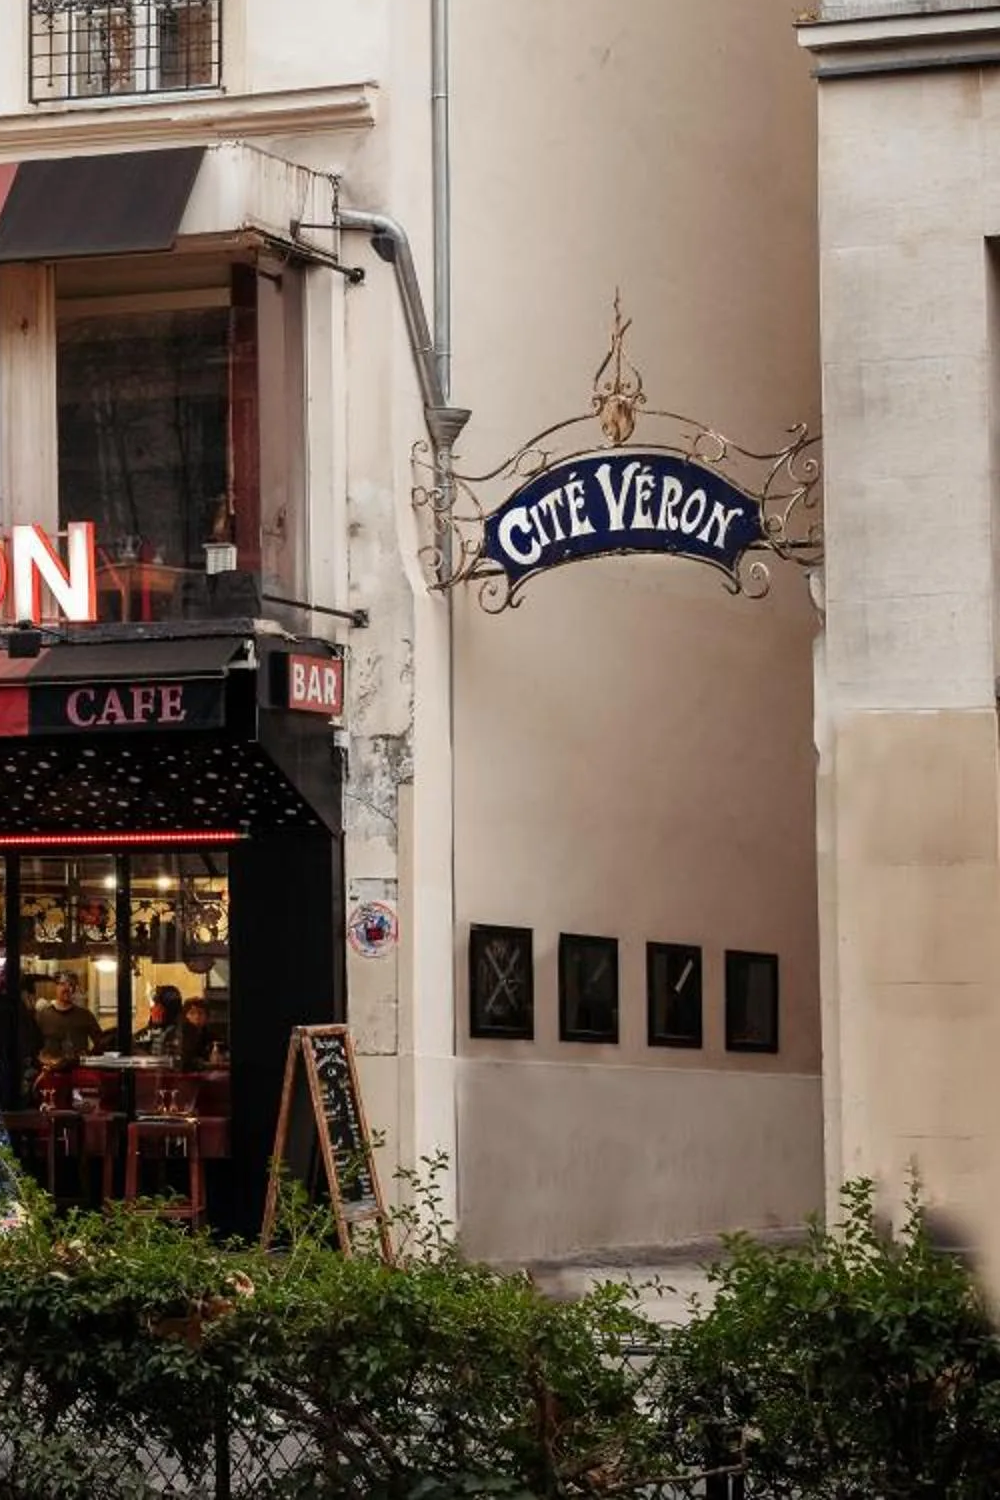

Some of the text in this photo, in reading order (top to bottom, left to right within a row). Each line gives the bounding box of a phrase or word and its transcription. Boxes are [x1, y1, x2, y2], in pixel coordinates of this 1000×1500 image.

[499, 461, 743, 565] CITÉ VÉRON
[292, 662, 338, 705] BAR
[66, 685, 188, 727] CAFE
